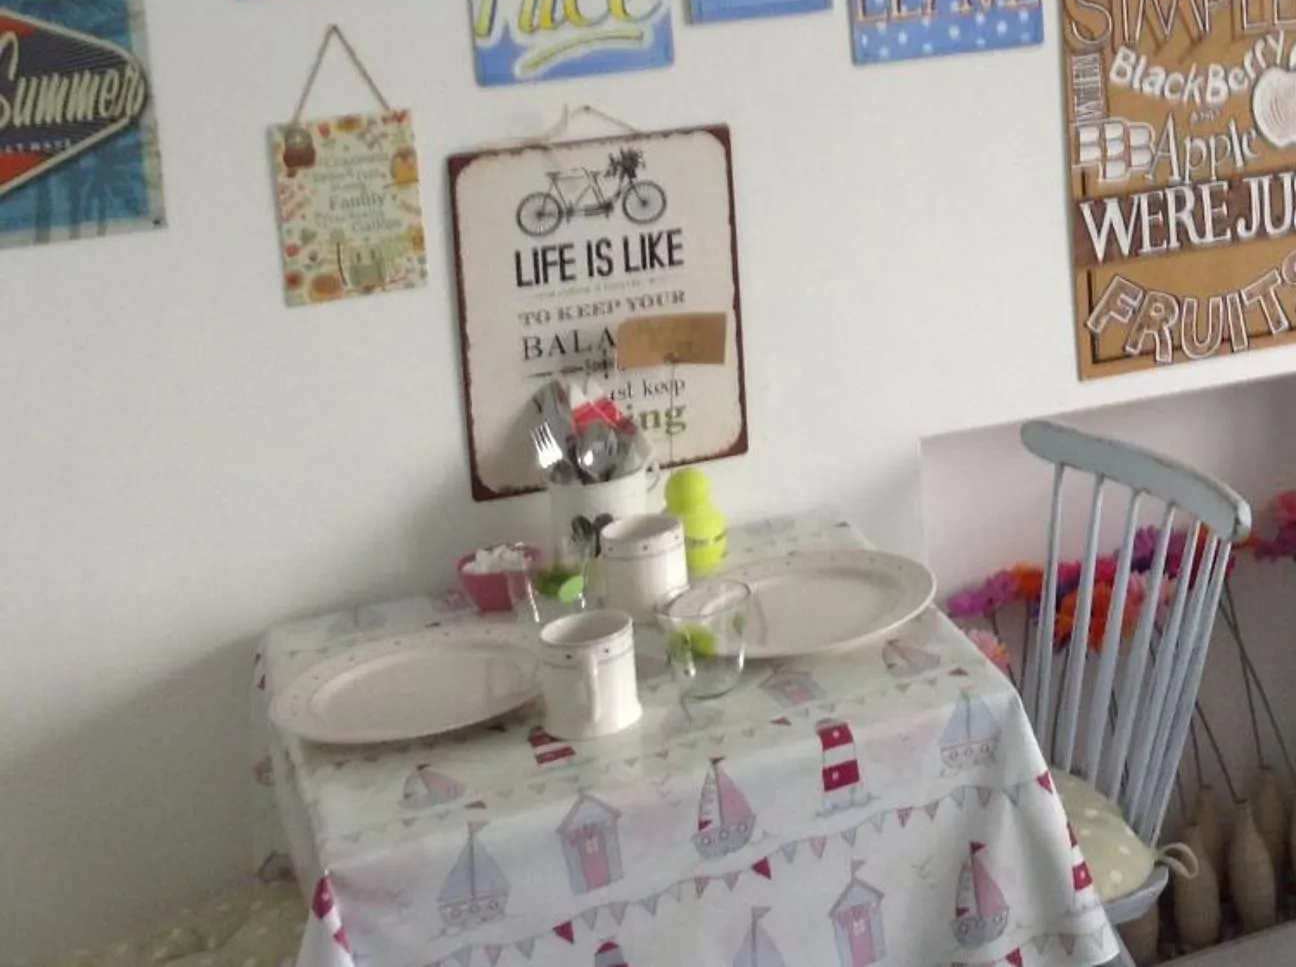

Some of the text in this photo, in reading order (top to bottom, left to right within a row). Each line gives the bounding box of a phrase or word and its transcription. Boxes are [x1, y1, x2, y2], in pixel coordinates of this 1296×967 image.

[1108, 30, 1287, 106] BlackBerry
[1149, 113, 1260, 184] Apple
[1079, 181, 1231, 263] WERE
[515, 243, 577, 288] LIFE
[587, 238, 613, 278] IS
[623, 228, 684, 273] LIKE
[518, 289, 687, 327] TO KEEP YOUR
[522, 325, 617, 362] BALA
[643, 378, 686, 397] keep
[626, 403, 687, 434] ing
